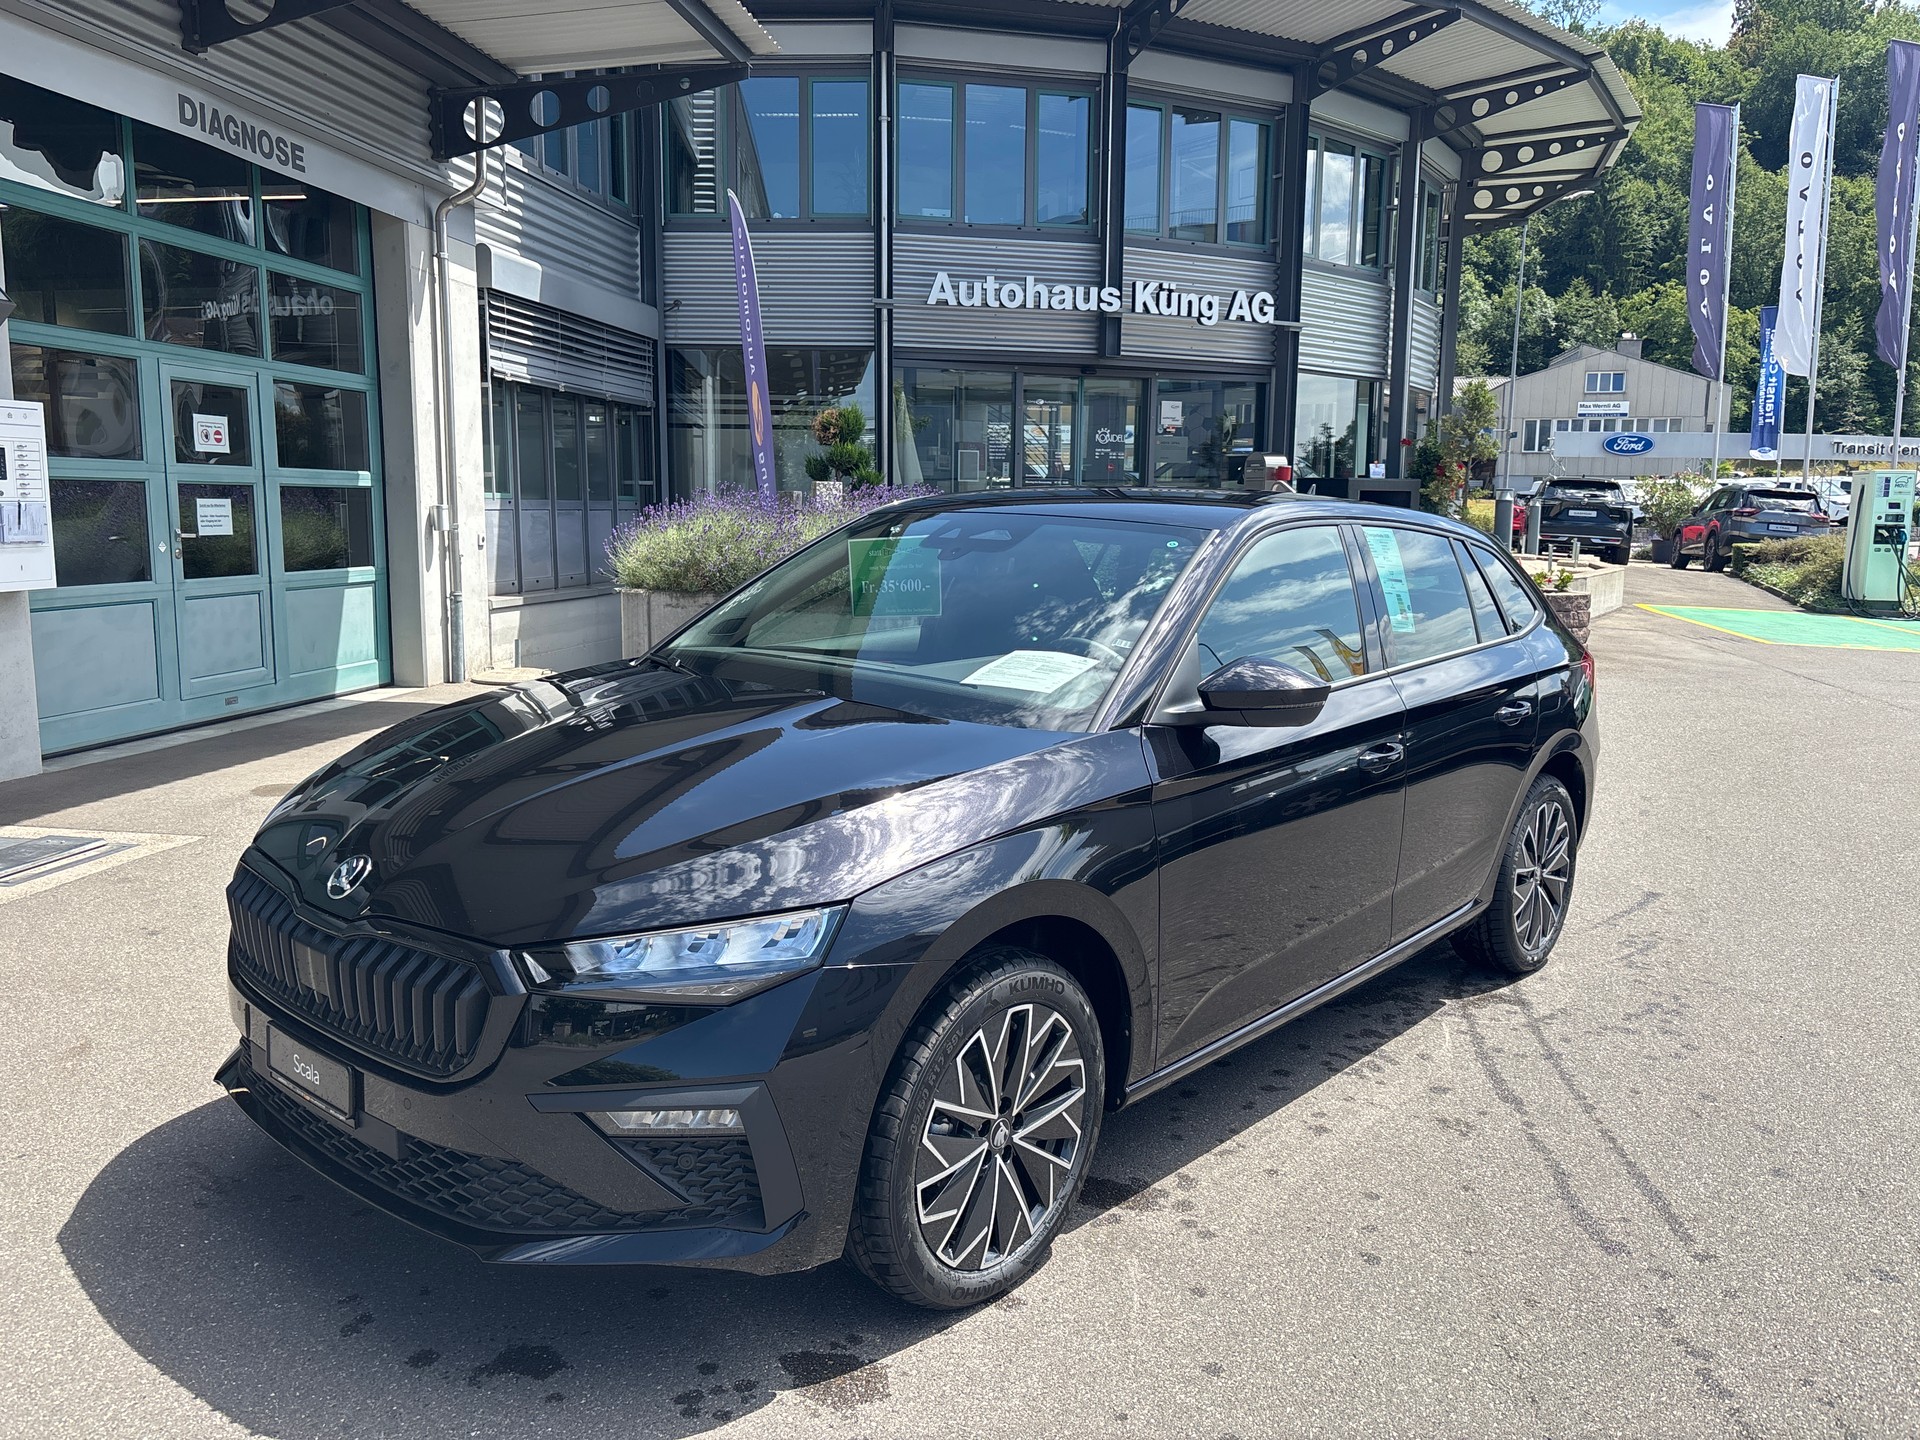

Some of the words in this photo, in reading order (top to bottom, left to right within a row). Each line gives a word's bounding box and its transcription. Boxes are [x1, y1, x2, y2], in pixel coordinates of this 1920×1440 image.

[178, 93, 306, 174] DIAGNOSE
[926, 271, 1122, 314] Autohaus
[1132, 280, 1220, 326] Küng
[1226, 289, 1276, 324] AG
[1613, 436, 1645, 451] Ford
[1833, 441, 1885, 456] Transit
[861, 580, 878, 594] Fr.
[1008, 976, 1065, 995] KUMHO
[293, 1054, 320, 1086] Scala
